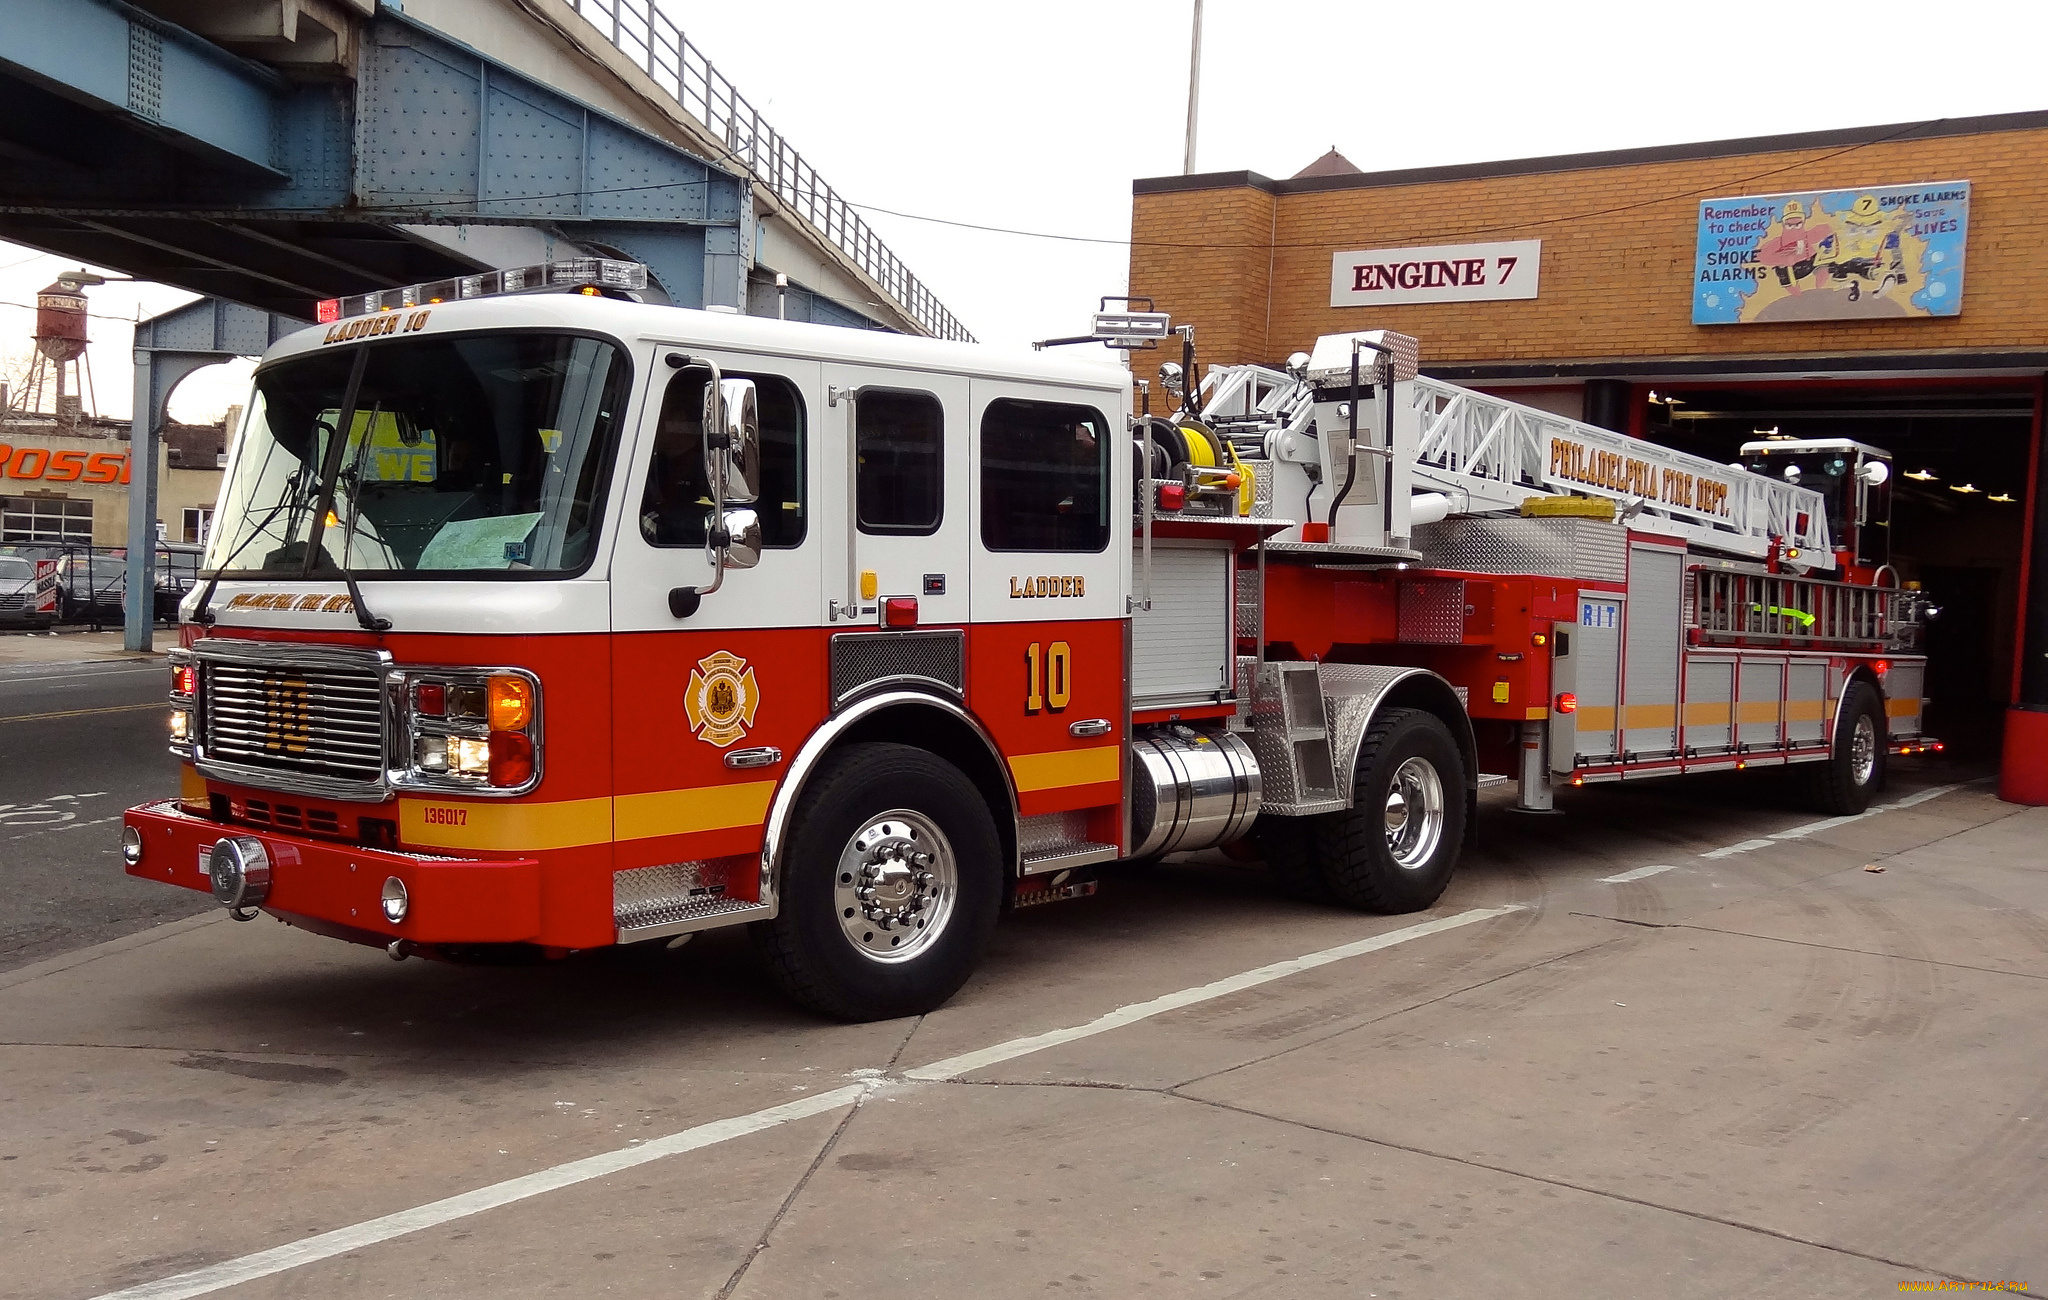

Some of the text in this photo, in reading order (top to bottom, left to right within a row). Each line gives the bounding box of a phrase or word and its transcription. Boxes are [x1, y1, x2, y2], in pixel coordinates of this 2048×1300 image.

[1788, 203, 1798, 212] 10
[1862, 199, 1872, 211] 7
[1880, 190, 1966, 207] SMOKE ALARMS
[1704, 203, 1776, 220] Remember
[1708, 219, 1767, 234] to check
[1911, 219, 1958, 237] LIVES
[1718, 234, 1752, 251] your
[1706, 249, 1762, 266] SMOKE
[1351, 256, 1518, 292] ENGINE 7
[1700, 266, 1768, 282] ALARMS
[322, 309, 432, 345] LADDER 10
[1549, 436, 1730, 518] PHILADELPHIA FIRE DEPT.
[1009, 575, 1085, 599] LADDER
[1583, 603, 1616, 628] RIT
[1024, 640, 1071, 717] 10
[1219, 664, 1224, 682] 1
[423, 806, 468, 826] 136017
